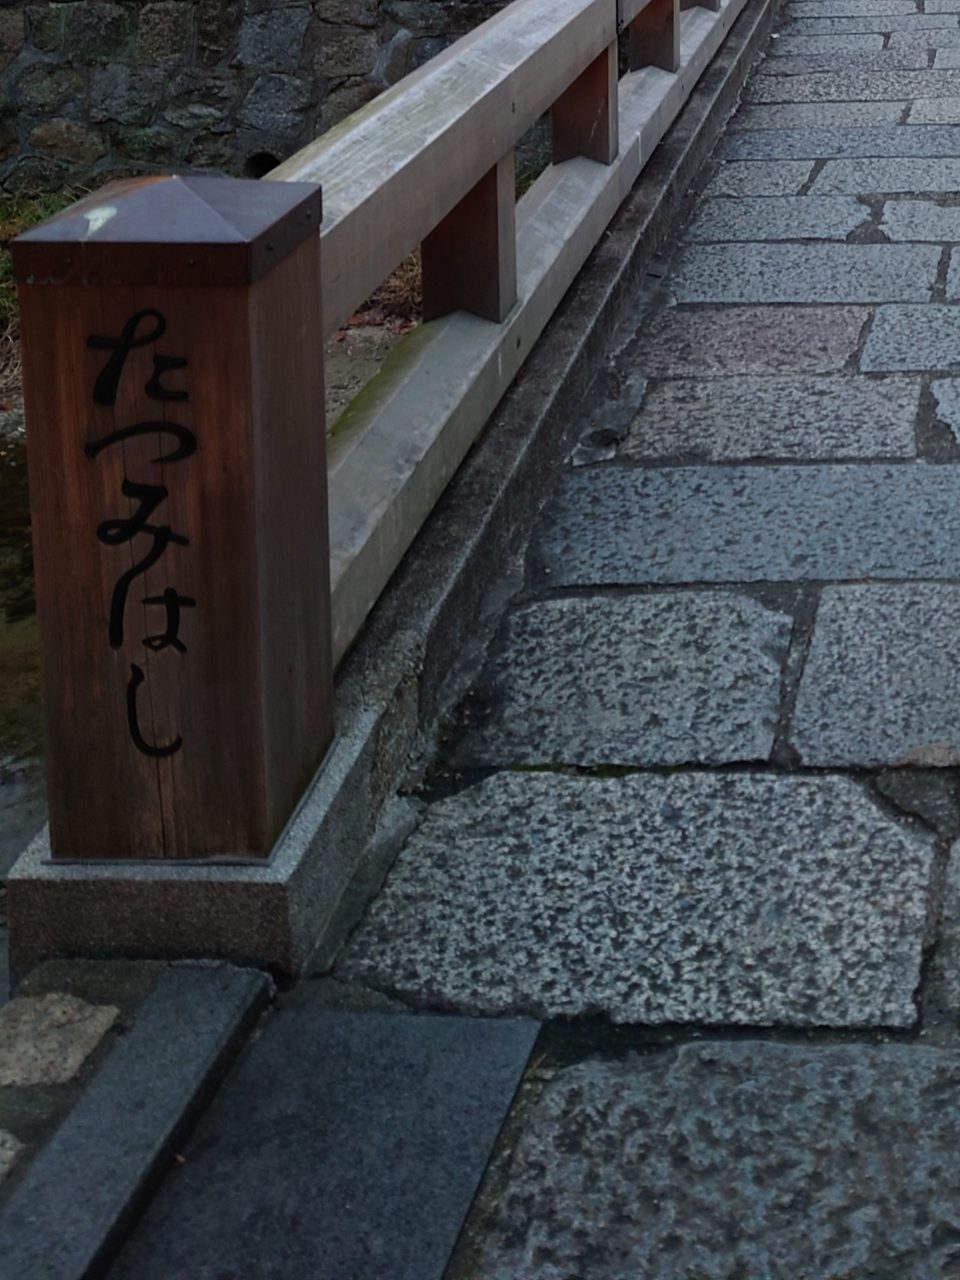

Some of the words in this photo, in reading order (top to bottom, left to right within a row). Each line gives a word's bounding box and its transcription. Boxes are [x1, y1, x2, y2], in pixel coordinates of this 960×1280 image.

[85, 308, 197, 757] たつみはし
